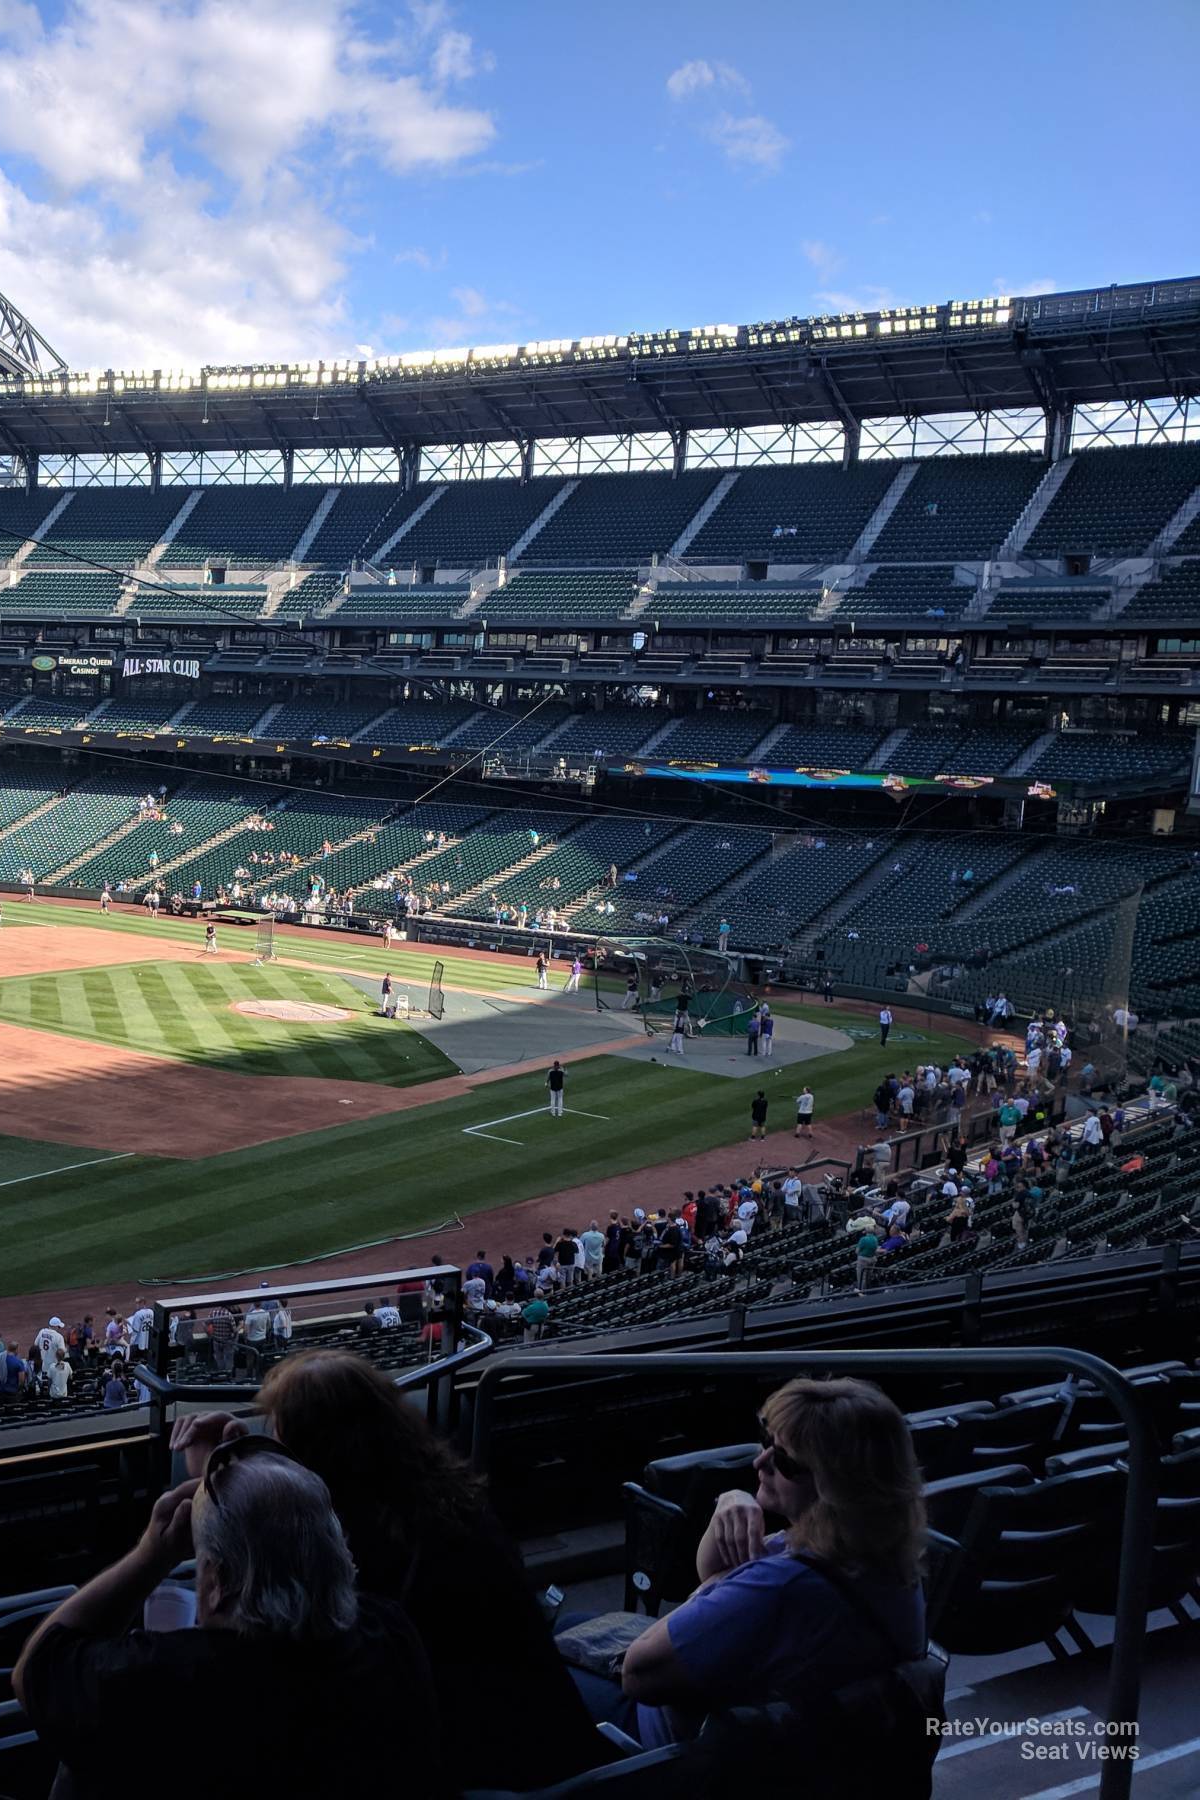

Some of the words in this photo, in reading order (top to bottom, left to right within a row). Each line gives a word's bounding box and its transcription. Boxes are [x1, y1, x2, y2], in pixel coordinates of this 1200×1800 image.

[58, 656, 88, 666] EMERALD
[89, 656, 113, 667] QUEEN
[71, 666, 99, 675] CASINOS
[173, 659, 200, 679] CLUB
